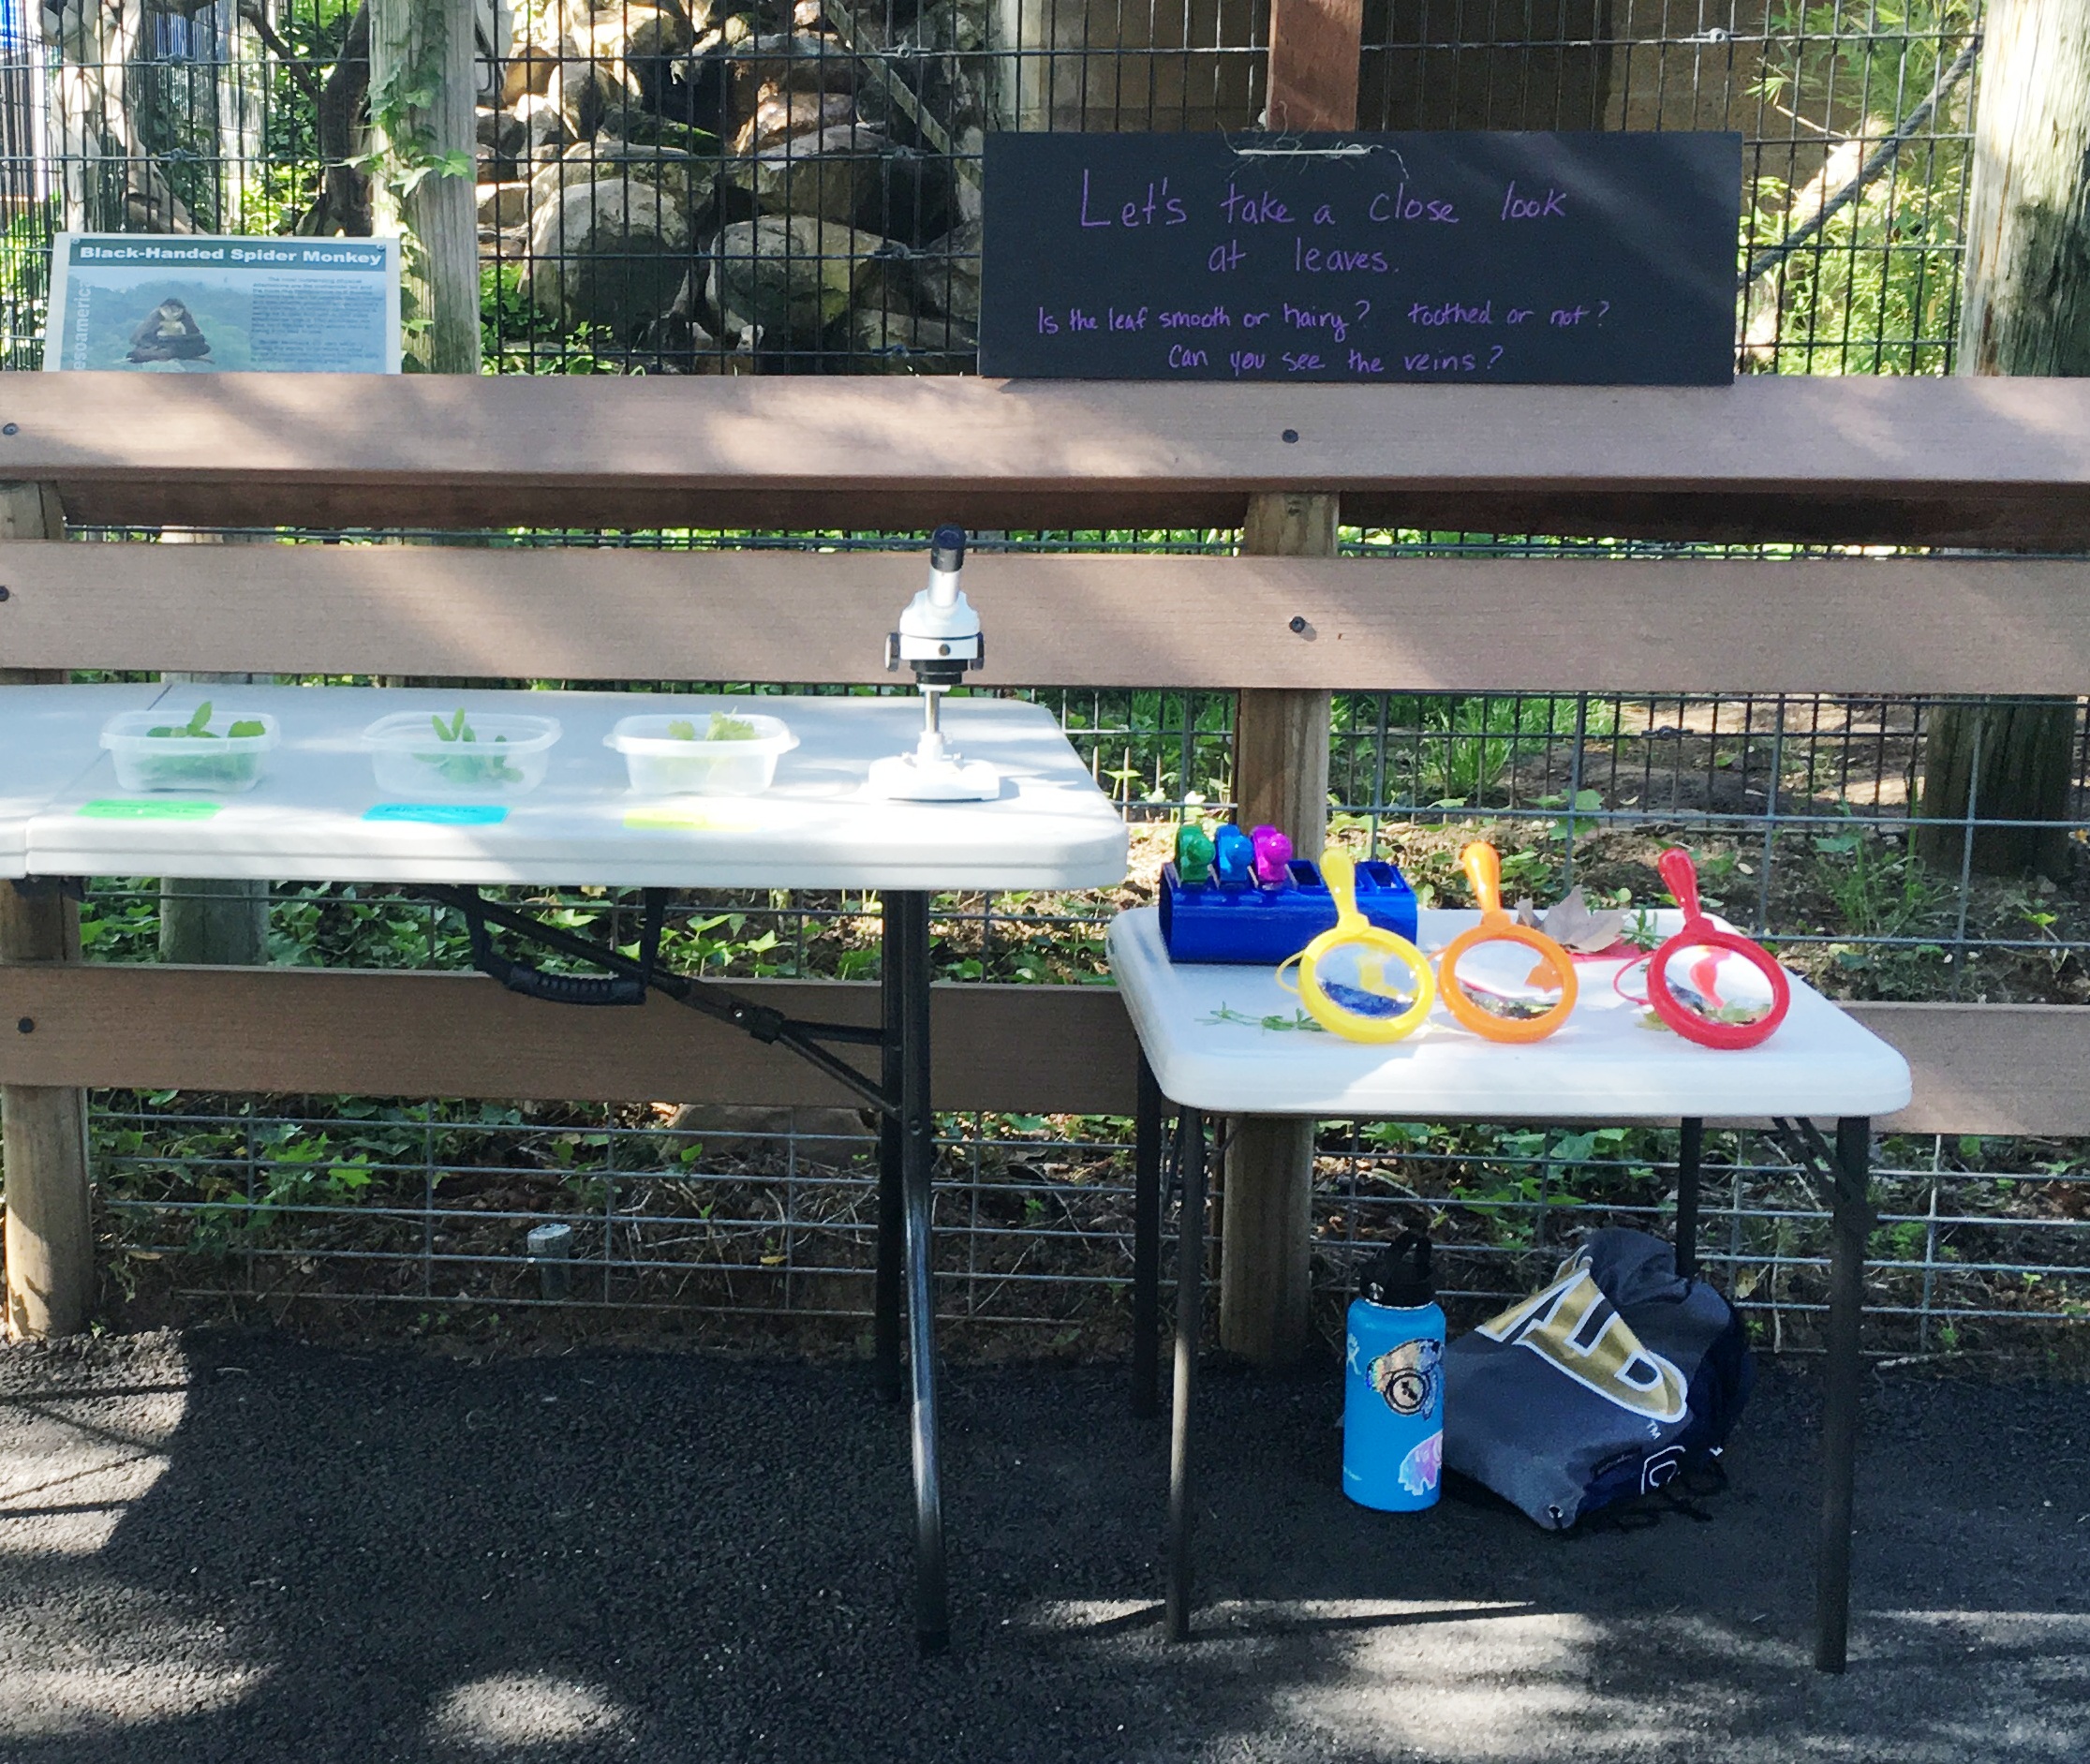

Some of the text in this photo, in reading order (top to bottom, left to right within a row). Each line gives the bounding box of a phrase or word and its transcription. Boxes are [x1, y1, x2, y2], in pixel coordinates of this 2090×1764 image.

[1081, 169, 1187, 227] Let's
[1220, 183, 1295, 224] take
[1313, 204, 1336, 225] a
[1501, 180, 1566, 221] look
[80, 246, 381, 266] Black-Handed Spider Monkey
[1208, 237, 1400, 273] at leaves.
[74, 280, 92, 370] esoamerica
[1038, 306, 1060, 334] Is
[1070, 307, 1099, 331] the
[1109, 306, 1149, 332] leaf
[1158, 305, 1231, 328] smooth
[1243, 312, 1270, 328] or
[1506, 308, 1534, 325] or
[1168, 344, 1208, 368] Can
[1230, 349, 1266, 377] you
[1282, 351, 1326, 372] see
[1348, 348, 1385, 373] the
